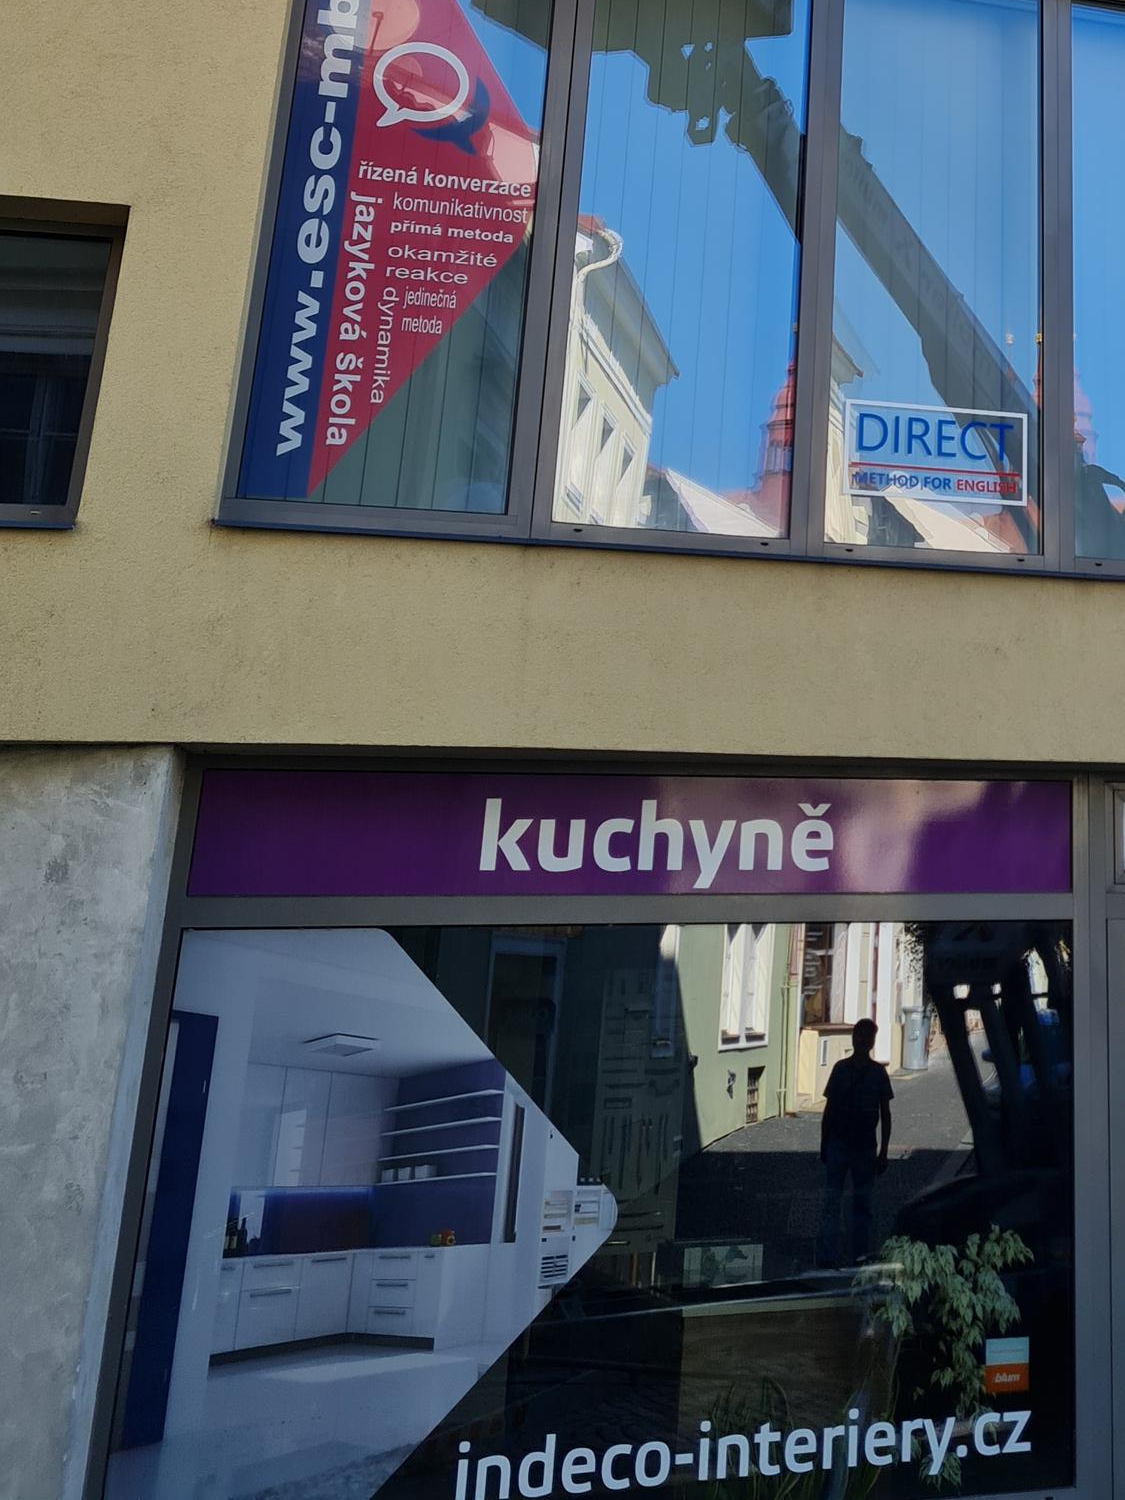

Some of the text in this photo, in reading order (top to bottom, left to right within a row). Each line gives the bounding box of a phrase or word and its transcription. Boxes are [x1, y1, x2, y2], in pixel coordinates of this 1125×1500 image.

[358, 160, 532, 198] řízená konverzace
[393, 191, 528, 224] komunikativnost
[390, 220, 513, 244] přímá metoda
[387, 245, 498, 268] okamžité
[385, 266, 469, 285] reakce
[402, 286, 457, 309] jedinečná
[325, 191, 382, 446] jazyková škola
[401, 315, 443, 335] metoda
[370, 286, 399, 404] dynamika
[856, 412, 1014, 462] DIRECT
[853, 470, 1017, 494] METHOD FOR ENGLISH
[479, 797, 834, 890] kuchyně
[454, 1407, 1033, 1500] indeco-interiery.cz
